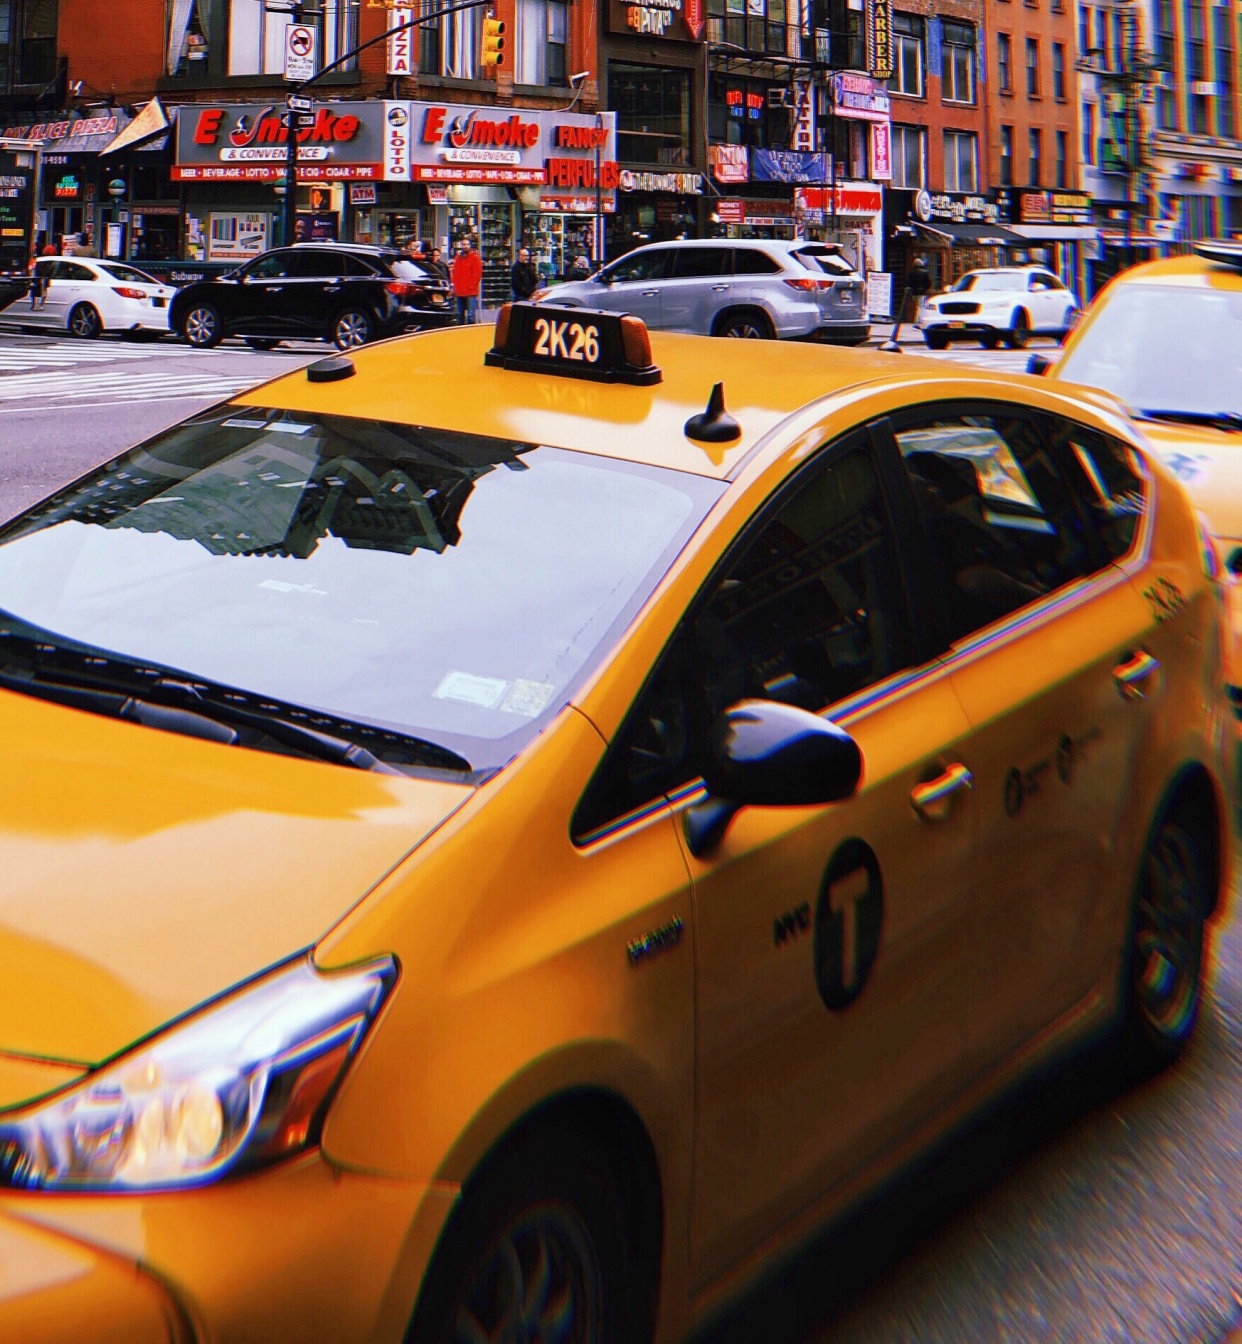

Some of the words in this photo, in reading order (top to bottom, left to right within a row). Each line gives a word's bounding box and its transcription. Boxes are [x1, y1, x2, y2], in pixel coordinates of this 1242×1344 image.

[28, 121, 70, 141] SLICE
[70, 116, 117, 137] PIZZA
[193, 109, 223, 144] E
[424, 107, 447, 142] E
[558, 126, 609, 149] FANCY
[228, 149, 236, 159] &
[240, 148, 320, 159] CONVENNCE
[390, 131, 405, 174] LOTTO
[180, 168, 196, 178] BEER
[203, 168, 240, 178] BEVERAGE
[246, 168, 269, 177] LOTTO
[326, 168, 349, 177] CIGAR
[357, 168, 372, 177] PIPE
[353, 189, 374, 199] ATM
[533, 318, 599, 363] 2K26
[829, 866, 870, 992] T
